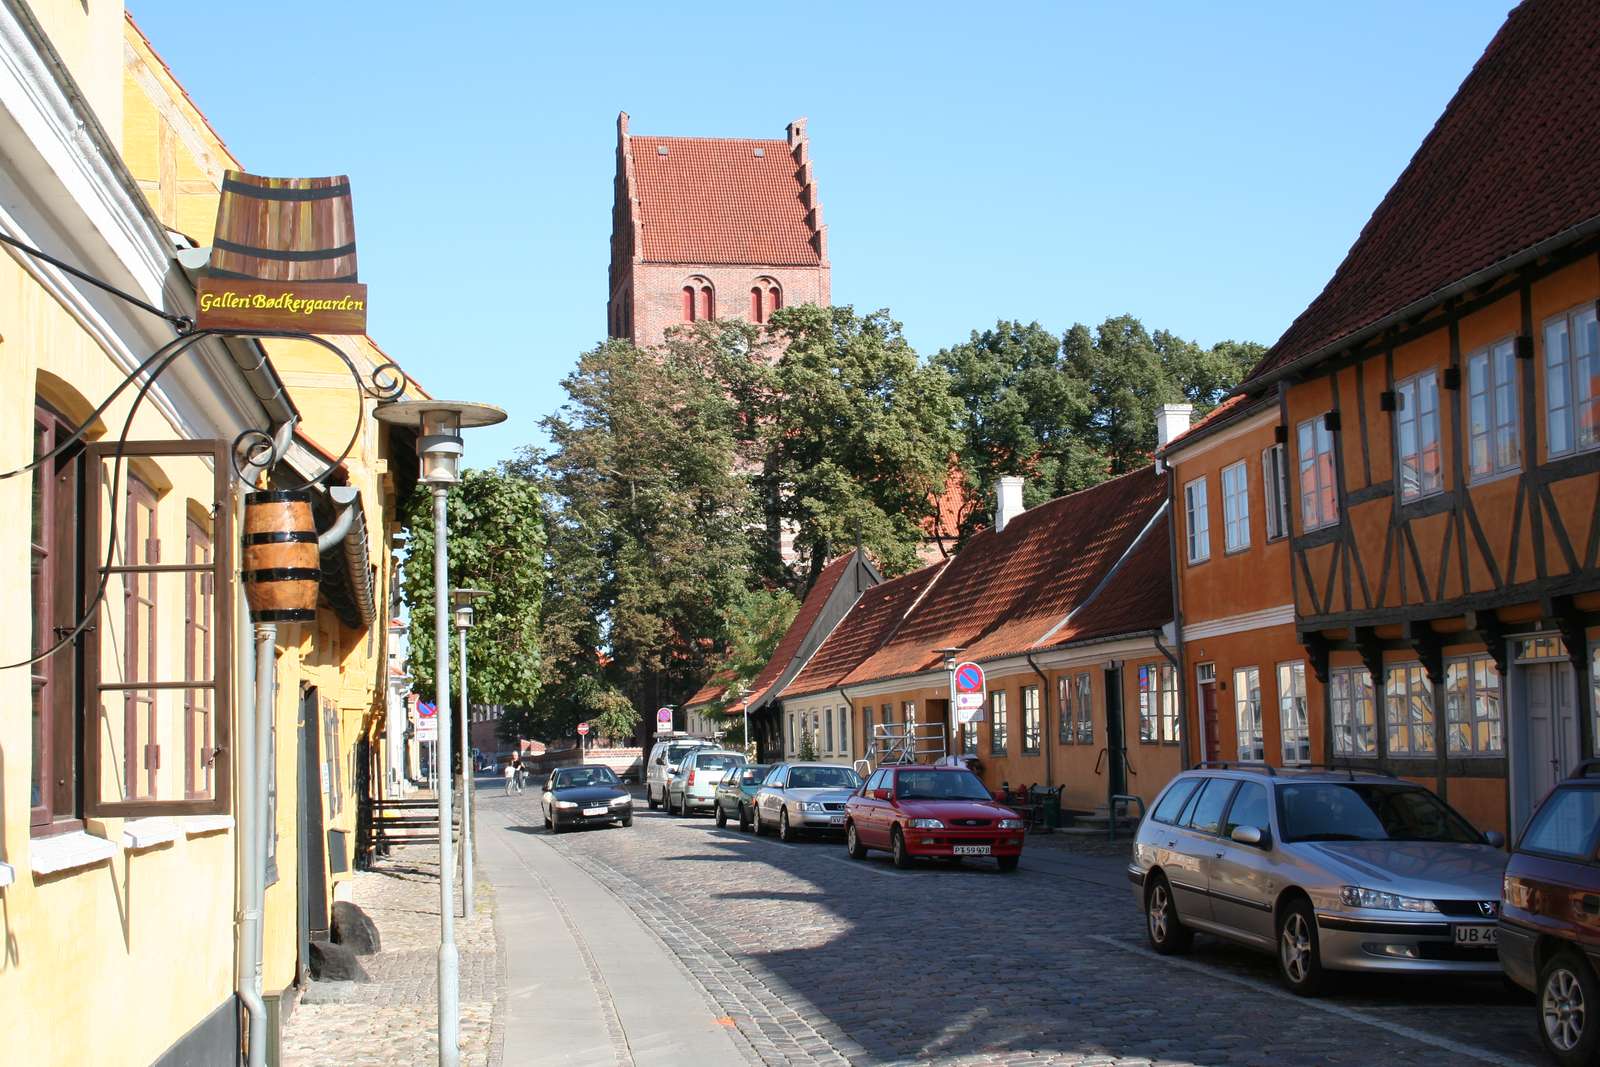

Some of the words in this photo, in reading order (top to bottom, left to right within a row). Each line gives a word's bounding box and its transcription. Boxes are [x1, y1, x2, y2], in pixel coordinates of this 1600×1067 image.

[200, 292, 251, 312] Galleri
[252, 293, 364, 315] Bødkergaarden
[1457, 928, 1479, 942] UB
